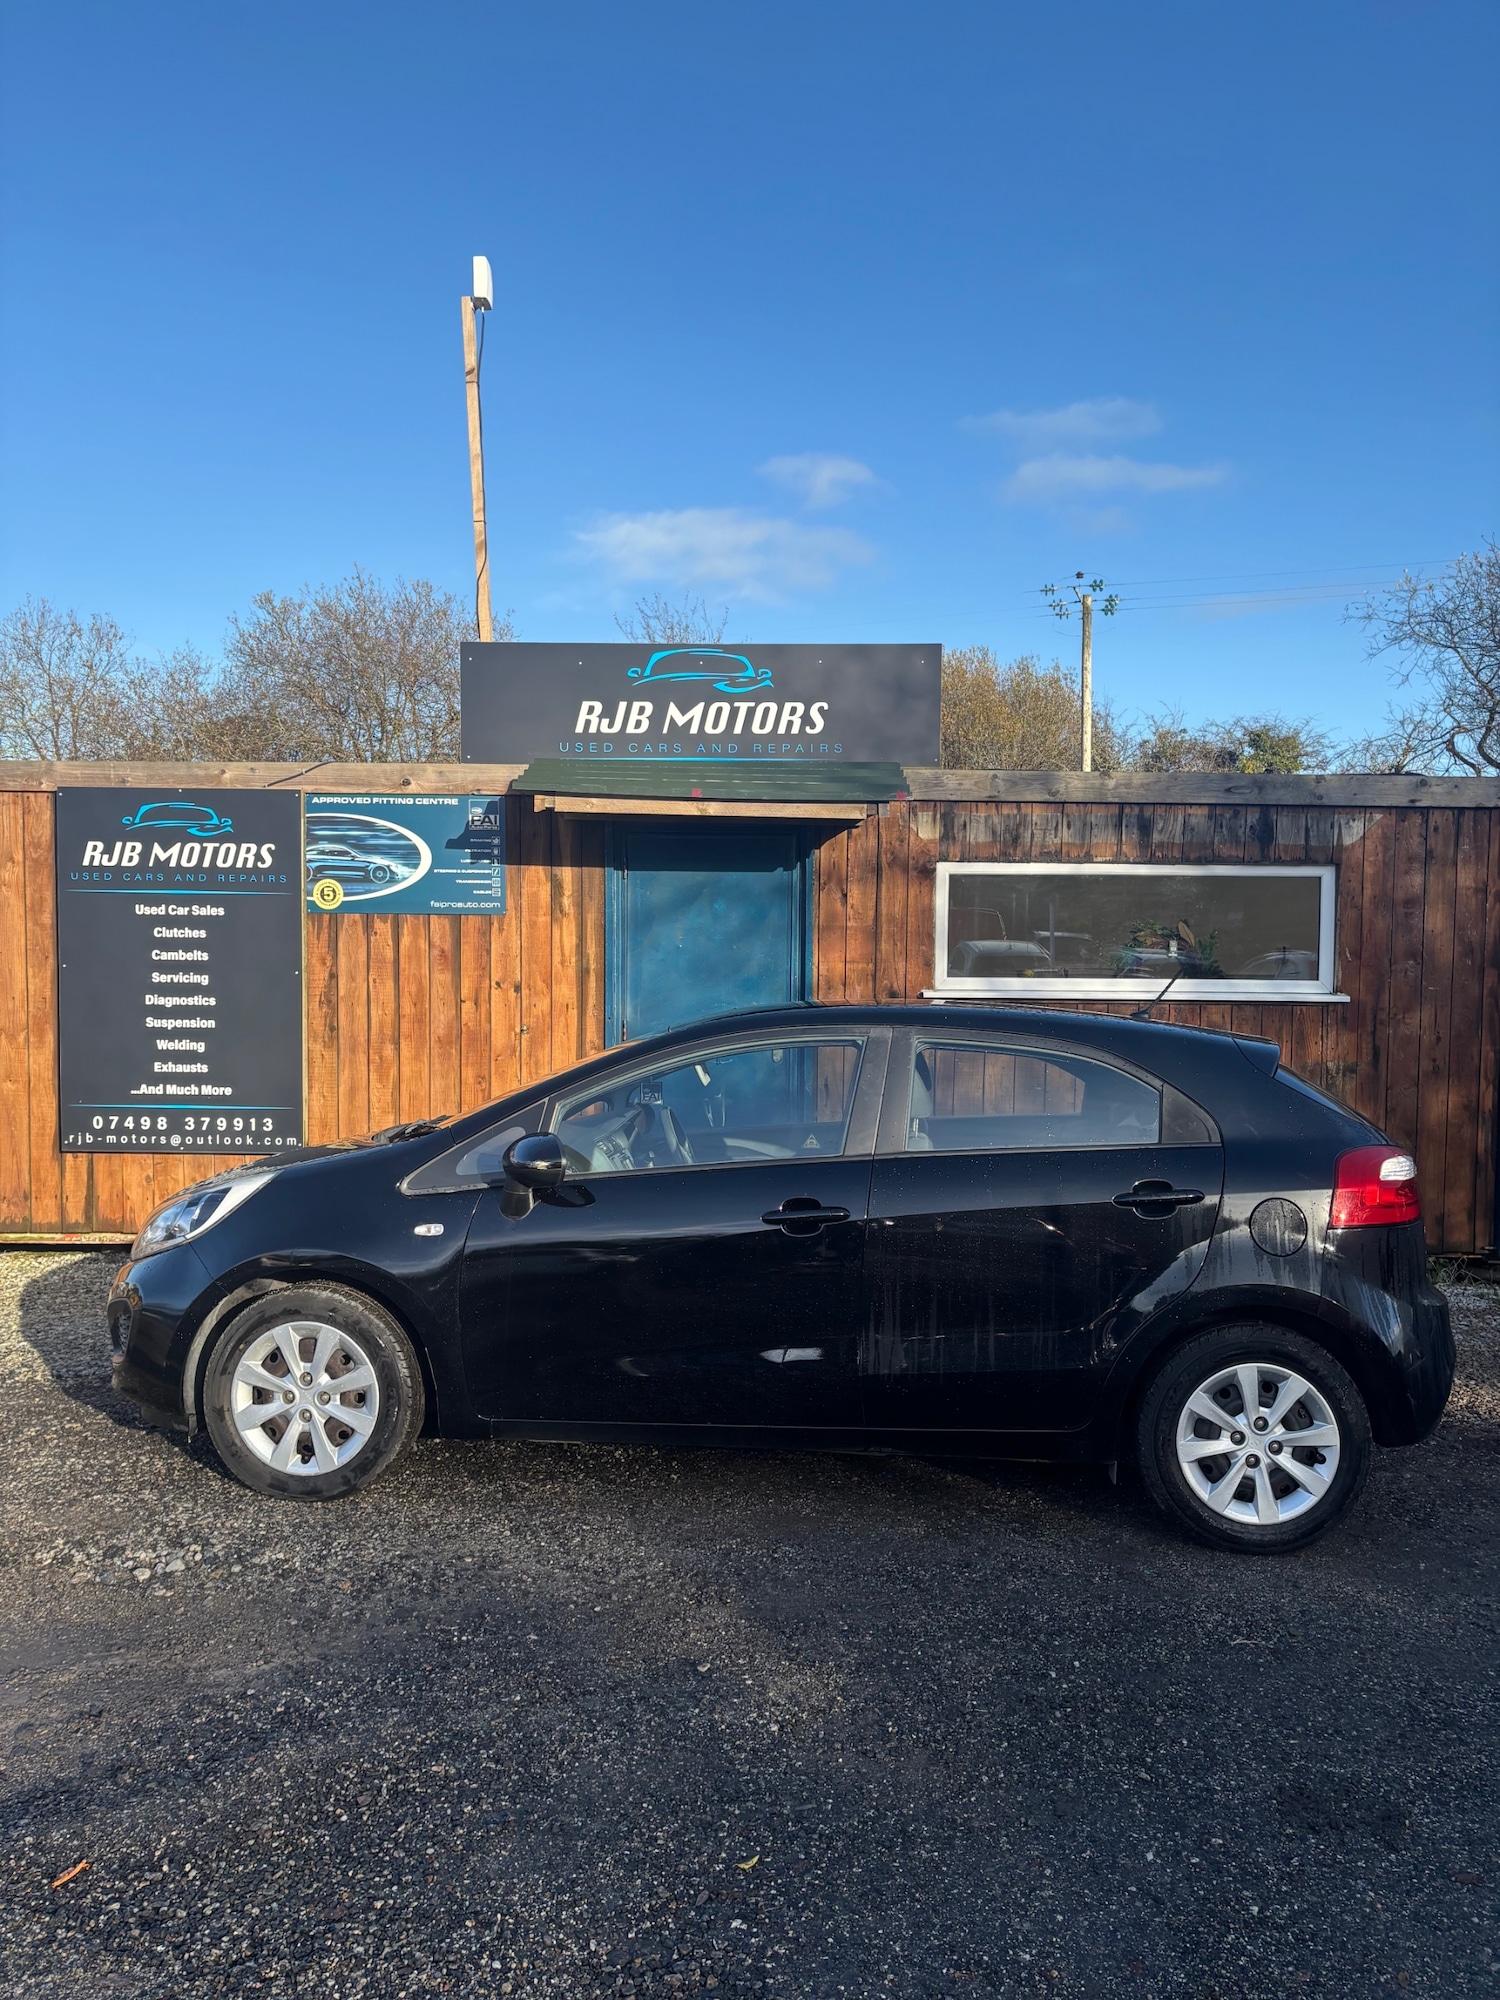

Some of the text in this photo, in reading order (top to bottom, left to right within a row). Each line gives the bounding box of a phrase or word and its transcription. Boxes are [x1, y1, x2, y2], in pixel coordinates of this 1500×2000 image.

[575, 701, 828, 734] RJB MOTORS
[559, 742, 843, 754] USED CARS AND REPAIRS
[311, 796, 459, 806] APPROVED FITTING CENTRE
[471, 815, 498, 825] FAI
[83, 841, 275, 868] RJB MOTORS
[70, 871, 287, 884] USED CARS AND REPAIRS
[323, 887, 334, 900] 5
[135, 904, 224, 915] Used Car Sales
[430, 900, 501, 909] faiproauto.com
[154, 927, 206, 938] Clutches
[152, 950, 209, 960] Cambelts
[152, 972, 208, 985] Servicing
[145, 994, 216, 1007] Diagnostics
[146, 1017, 215, 1030] Suspension
[156, 1039, 205, 1052] Welding
[154, 1062, 208, 1072] Exhausts
[131, 1084, 232, 1095] ...And Much More
[93, 1116, 273, 1131] 07498 379913
[69, 1133, 297, 1146] rjb-motors@outlook.com
